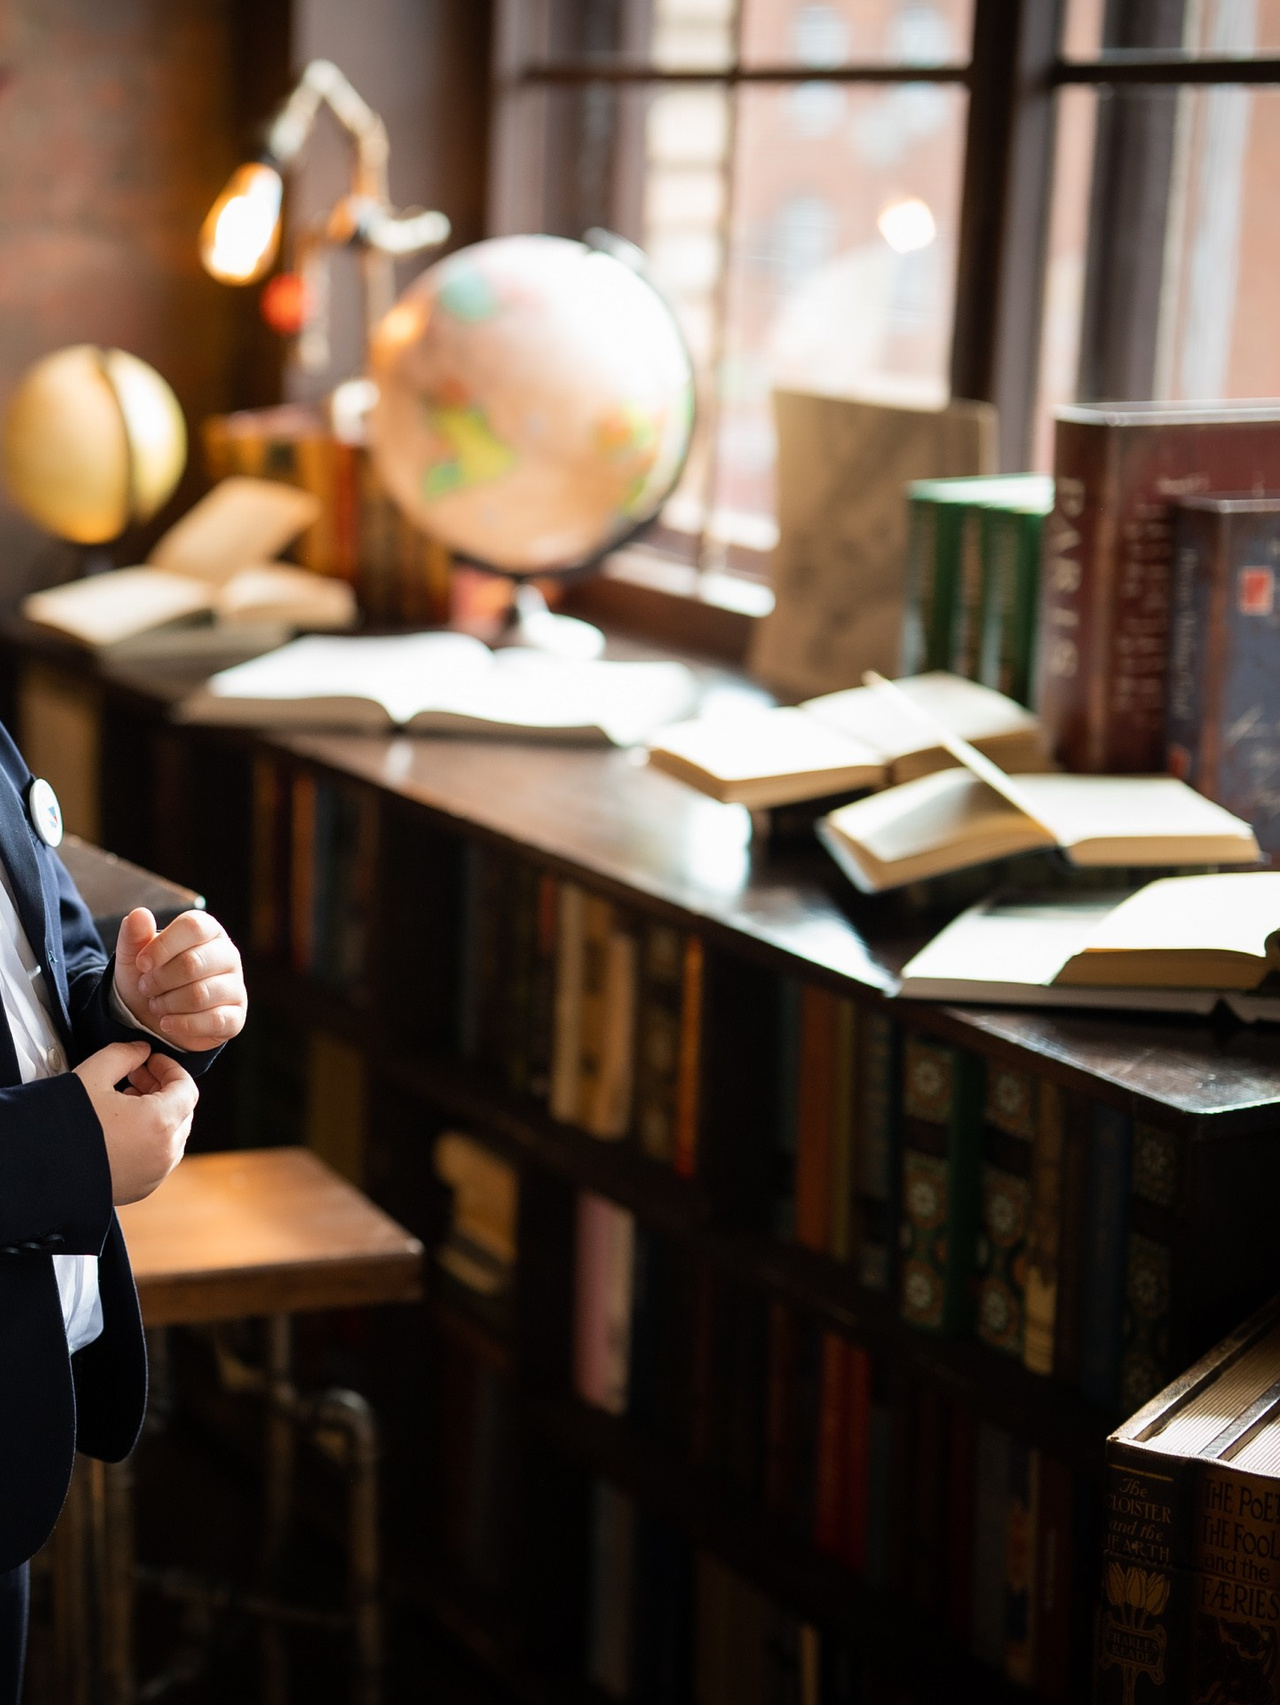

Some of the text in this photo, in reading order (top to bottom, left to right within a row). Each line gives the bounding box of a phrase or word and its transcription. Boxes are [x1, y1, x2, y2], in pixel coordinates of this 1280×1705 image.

[1120, 1478, 1148, 1498] The
[1205, 1479, 1233, 1513] THE
[1105, 1494, 1172, 1524] CLOISTER
[1109, 1519, 1164, 1542] and the
[1201, 1514, 1230, 1550] THE
[1101, 1533, 1171, 1563] HEARTH
[1205, 1554, 1271, 1583] and the
[1107, 1631, 1159, 1652] CHARLES
[1112, 1643, 1155, 1664] READE
